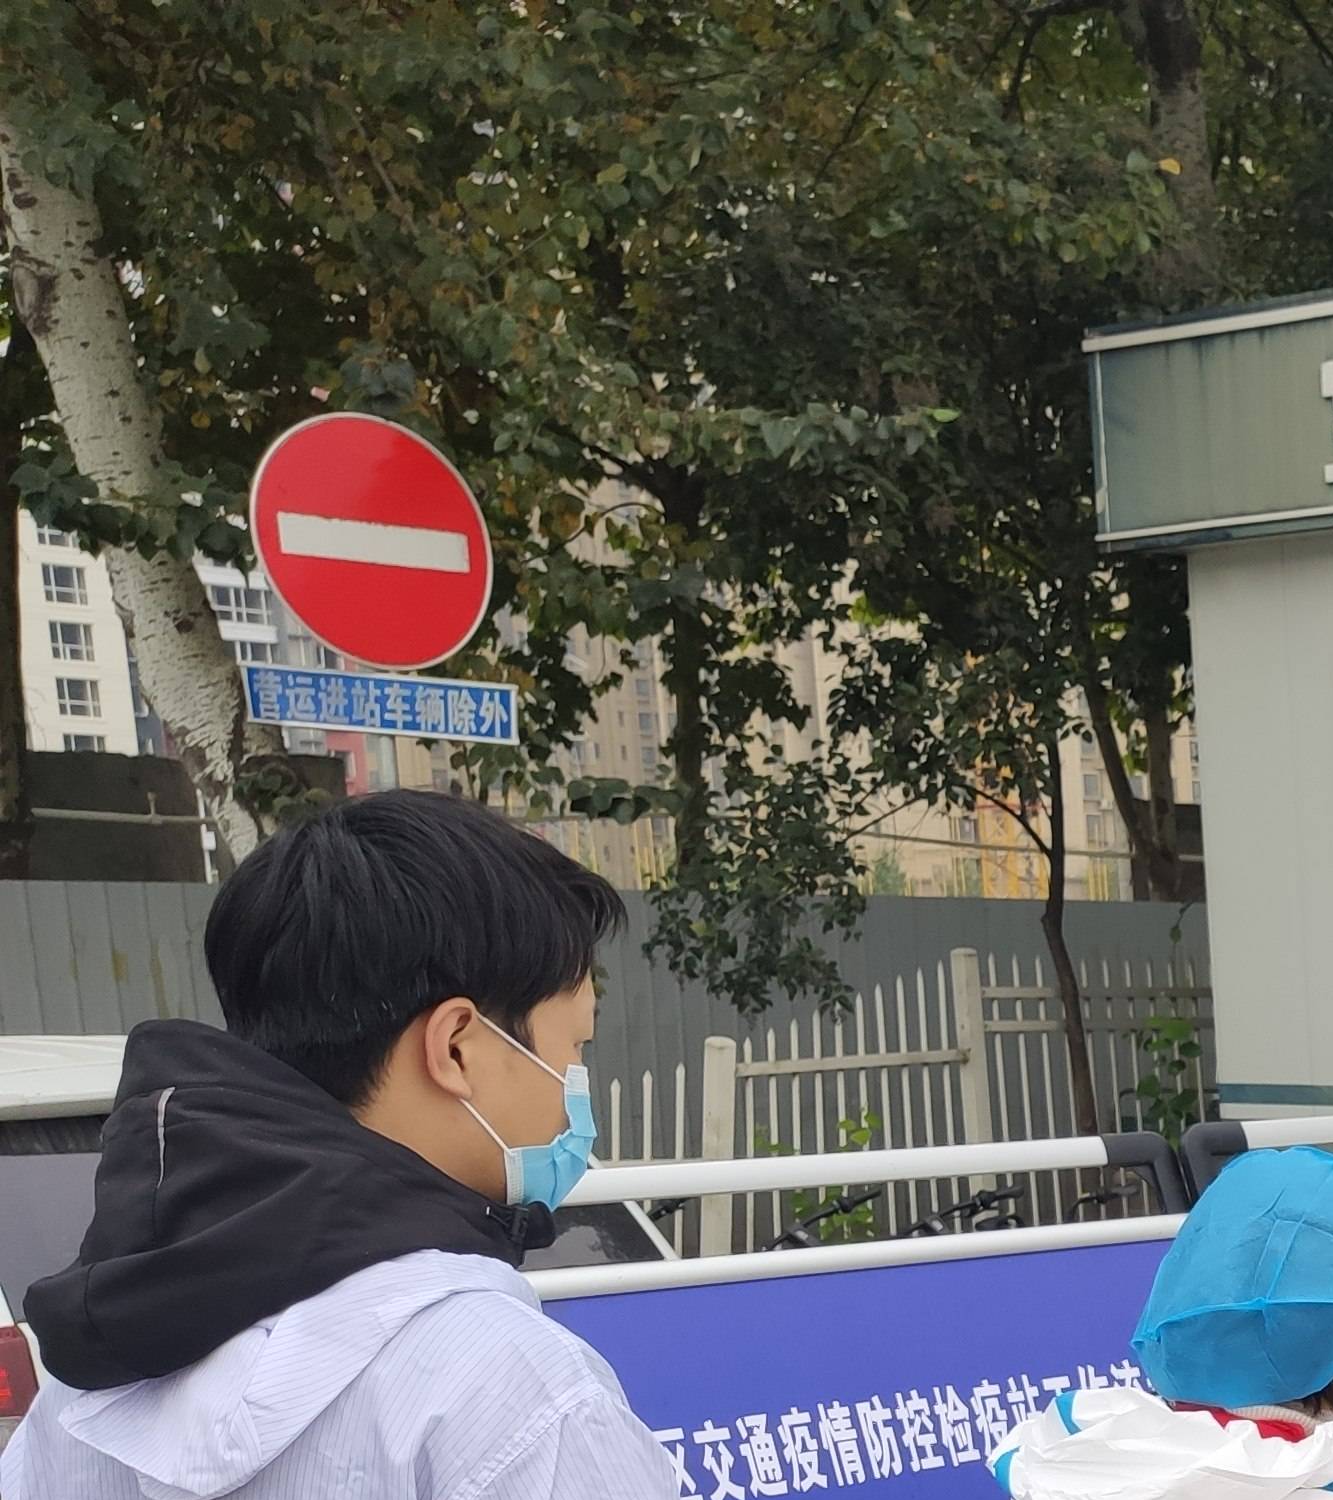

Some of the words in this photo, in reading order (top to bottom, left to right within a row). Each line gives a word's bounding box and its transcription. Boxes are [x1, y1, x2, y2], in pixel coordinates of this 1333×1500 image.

[253, 670, 509, 737] 营运进站车辆除外
